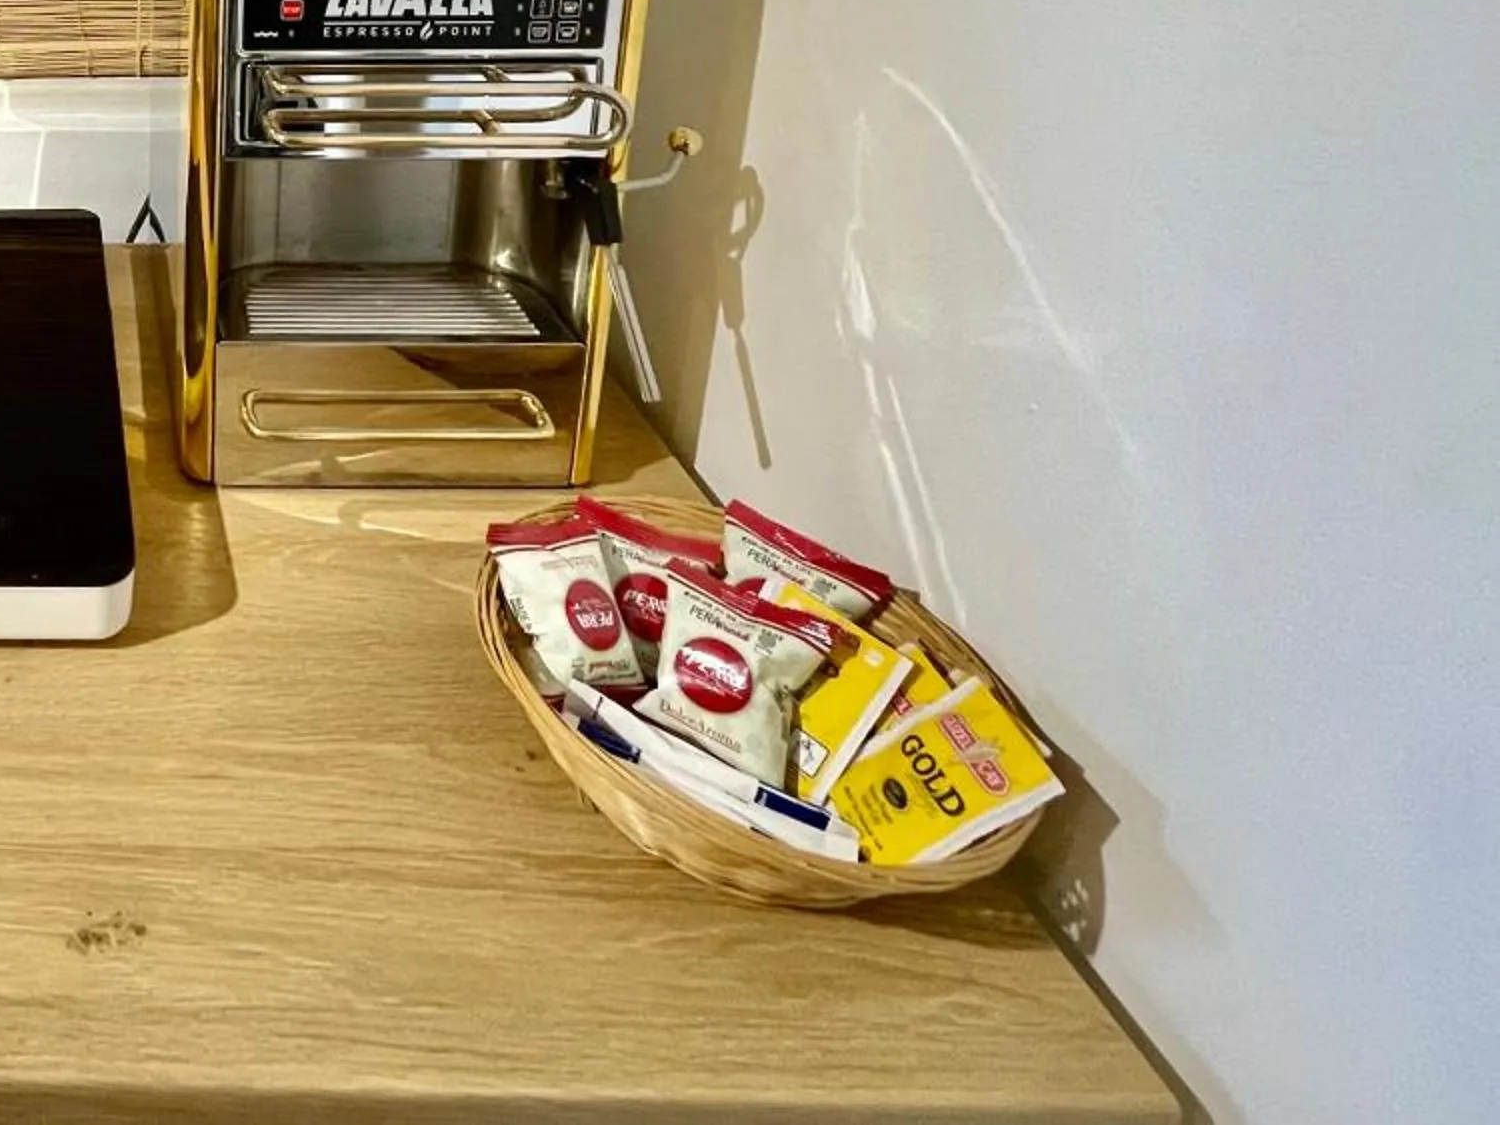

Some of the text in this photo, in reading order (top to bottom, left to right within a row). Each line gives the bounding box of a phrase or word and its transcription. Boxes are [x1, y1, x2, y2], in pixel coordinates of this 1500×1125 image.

[323, 26, 493, 38] ESPRESSO POINT
[901, 735, 965, 816] GOLD
